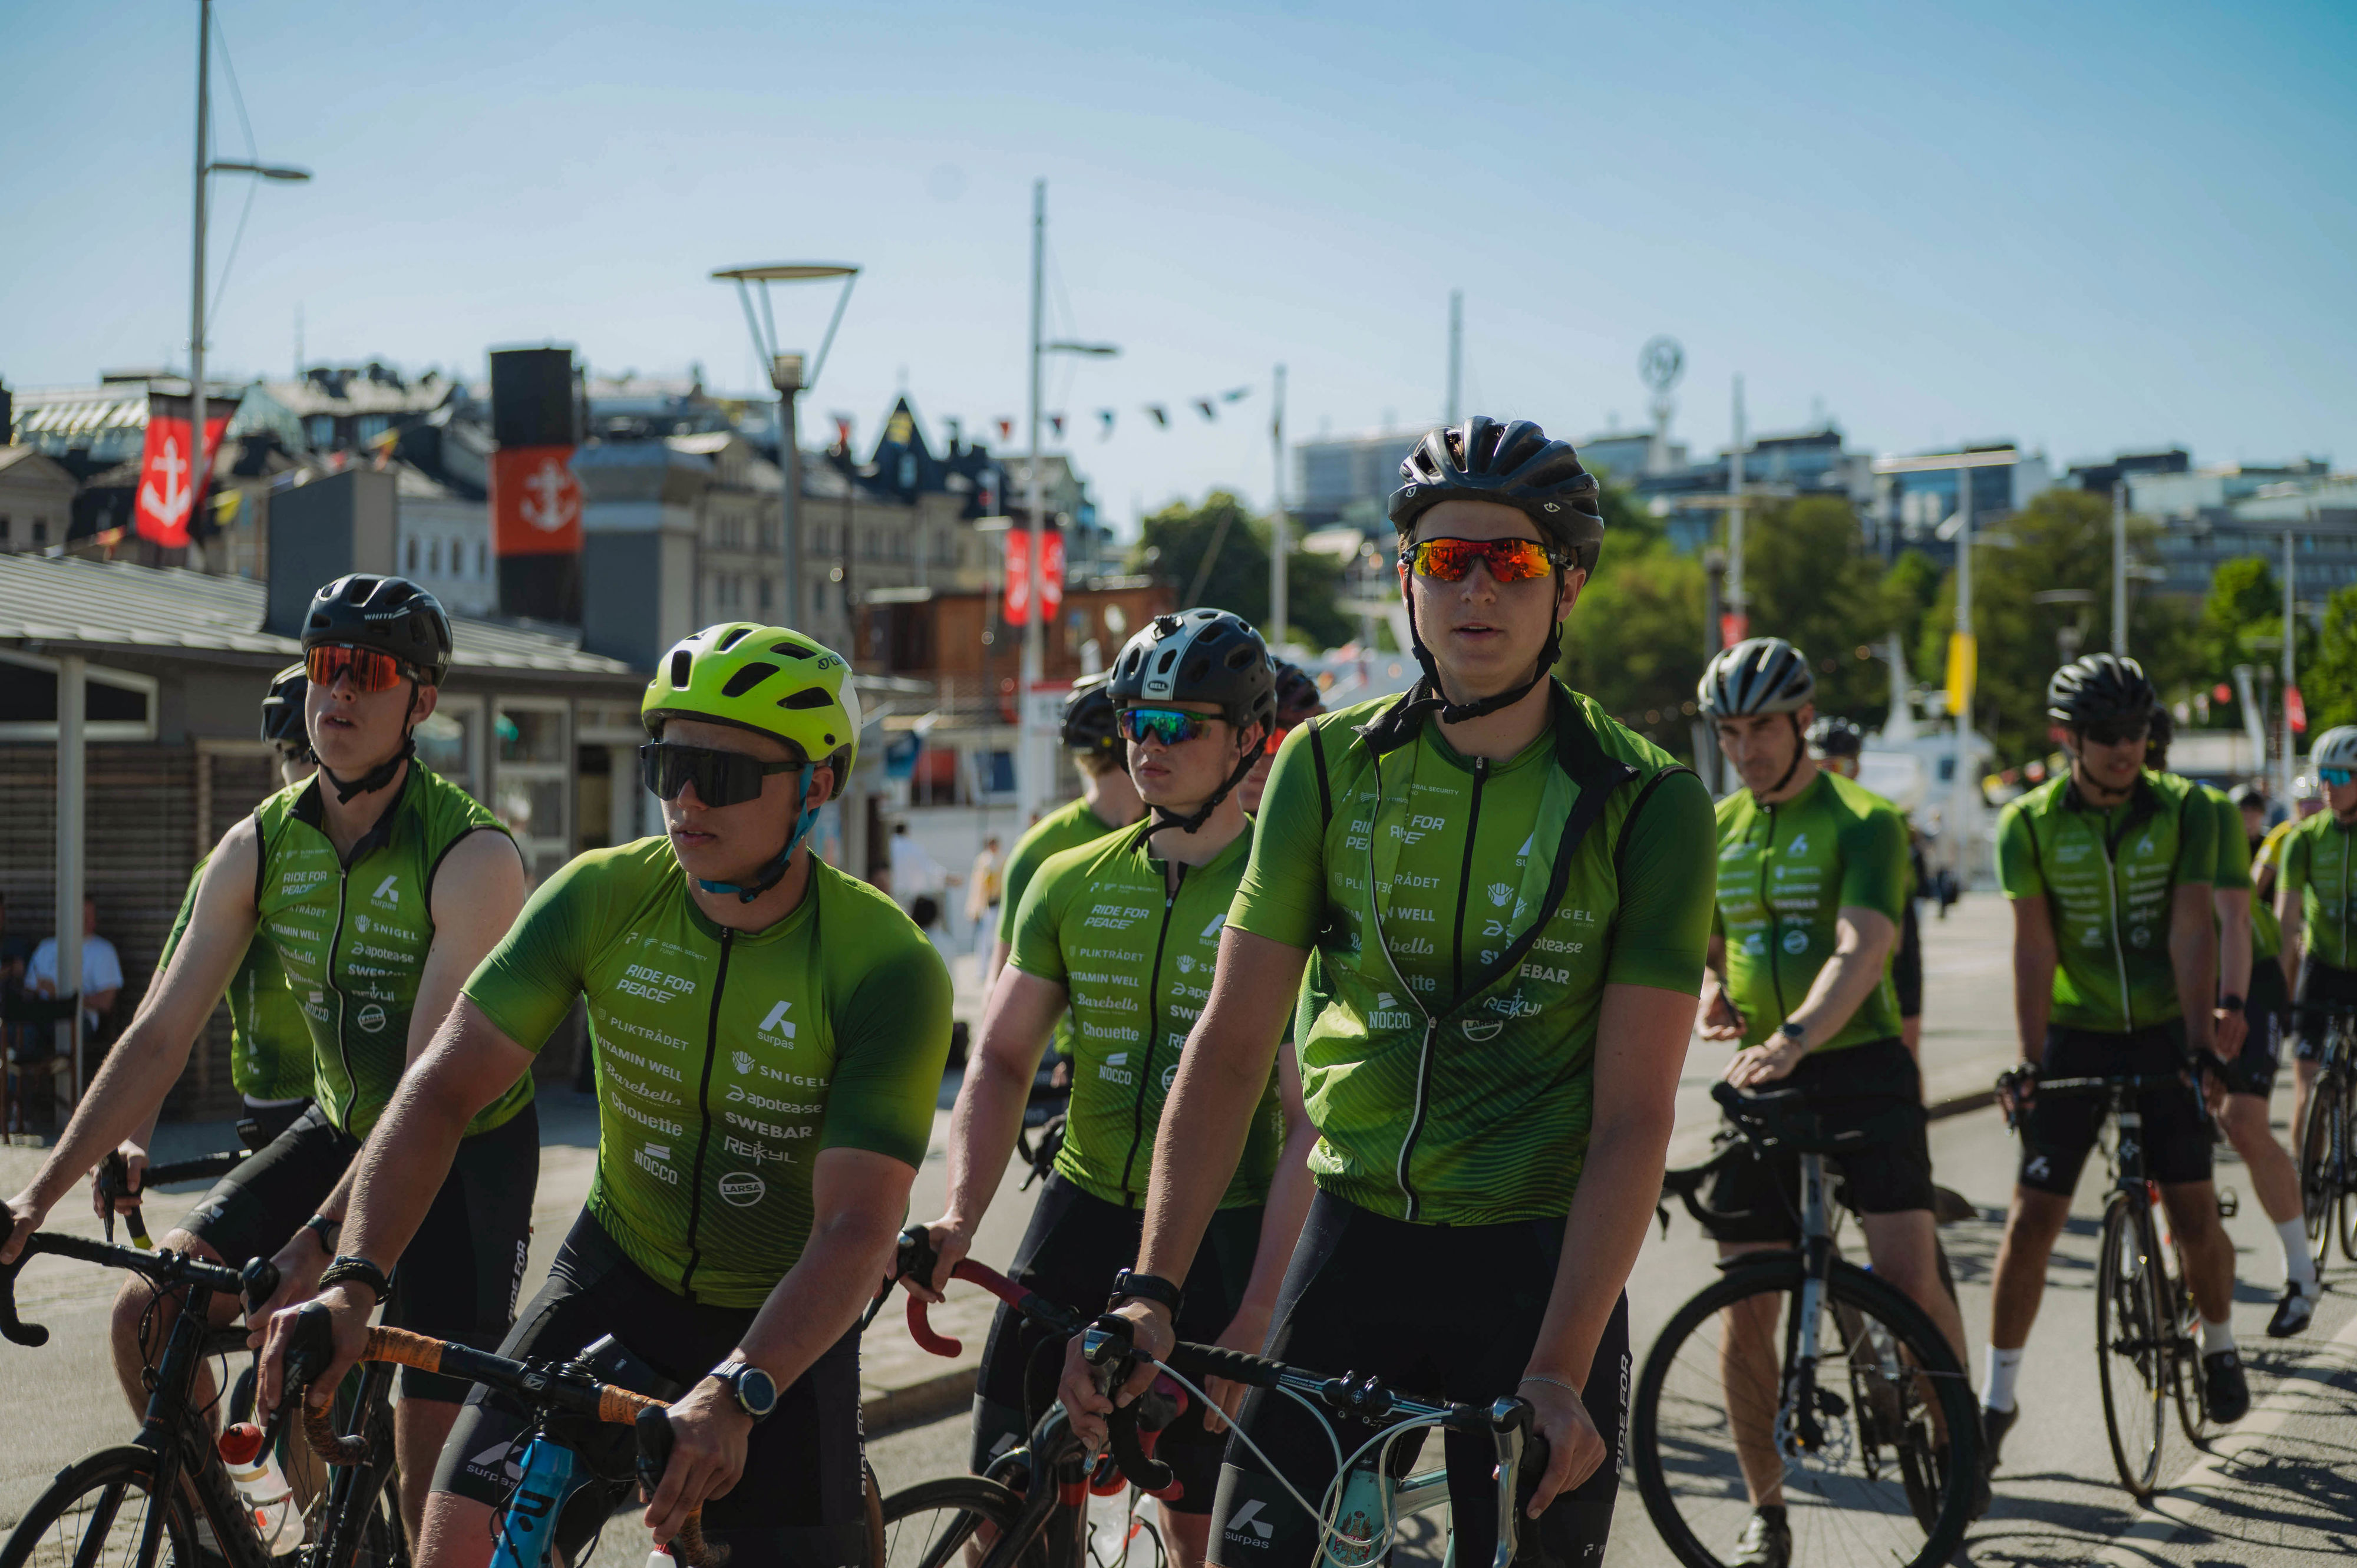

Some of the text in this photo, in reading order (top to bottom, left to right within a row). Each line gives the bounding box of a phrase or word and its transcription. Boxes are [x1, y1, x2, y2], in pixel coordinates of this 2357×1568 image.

[1428, 785, 1460, 795] SECURITY
[1411, 815, 1445, 831] FOR
[283, 870, 327, 883] RIDE FOR
[1091, 905, 1150, 919] RIDE FOR
[1397, 906, 1435, 922] WELL
[270, 922, 321, 942] VITAMIN WELL
[373, 922, 419, 941] SNIGEL
[1084, 916, 1134, 929] PEACE
[659, 948, 675, 956] FUND
[661, 942, 684, 953] GLOBAL
[1080, 948, 1145, 962] PLIKTRÅDET
[625, 963, 696, 995] RIDE FOR
[1071, 971, 1140, 988] VITAMIN WELL
[616, 979, 677, 1004] PEACE
[1077, 992, 1138, 1012] Barebells
[1368, 1011, 1411, 1029] NOCCO
[610, 1016, 689, 1051] PLIKTRÅDET
[757, 1031, 794, 1050] surpas
[1083, 1021, 1140, 1041] Chouette
[596, 1033, 683, 1082] VITAMIN WELL
[606, 1061, 682, 1106] Barebells
[760, 1065, 830, 1088] SNIGEL
[1099, 1065, 1132, 1085] NOCCO
[611, 1091, 684, 1137] Chouette
[724, 1111, 813, 1139] SWEBAR
[724, 1135, 799, 1167] REKYL
[634, 1148, 678, 1186] NOCCO
[722, 1183, 762, 1193] LARSA
[508, 1239, 526, 1325] RIDE FOR
[1615, 1354, 1629, 1475] RIDE FOR
[1224, 1531, 1269, 1549] surpas
